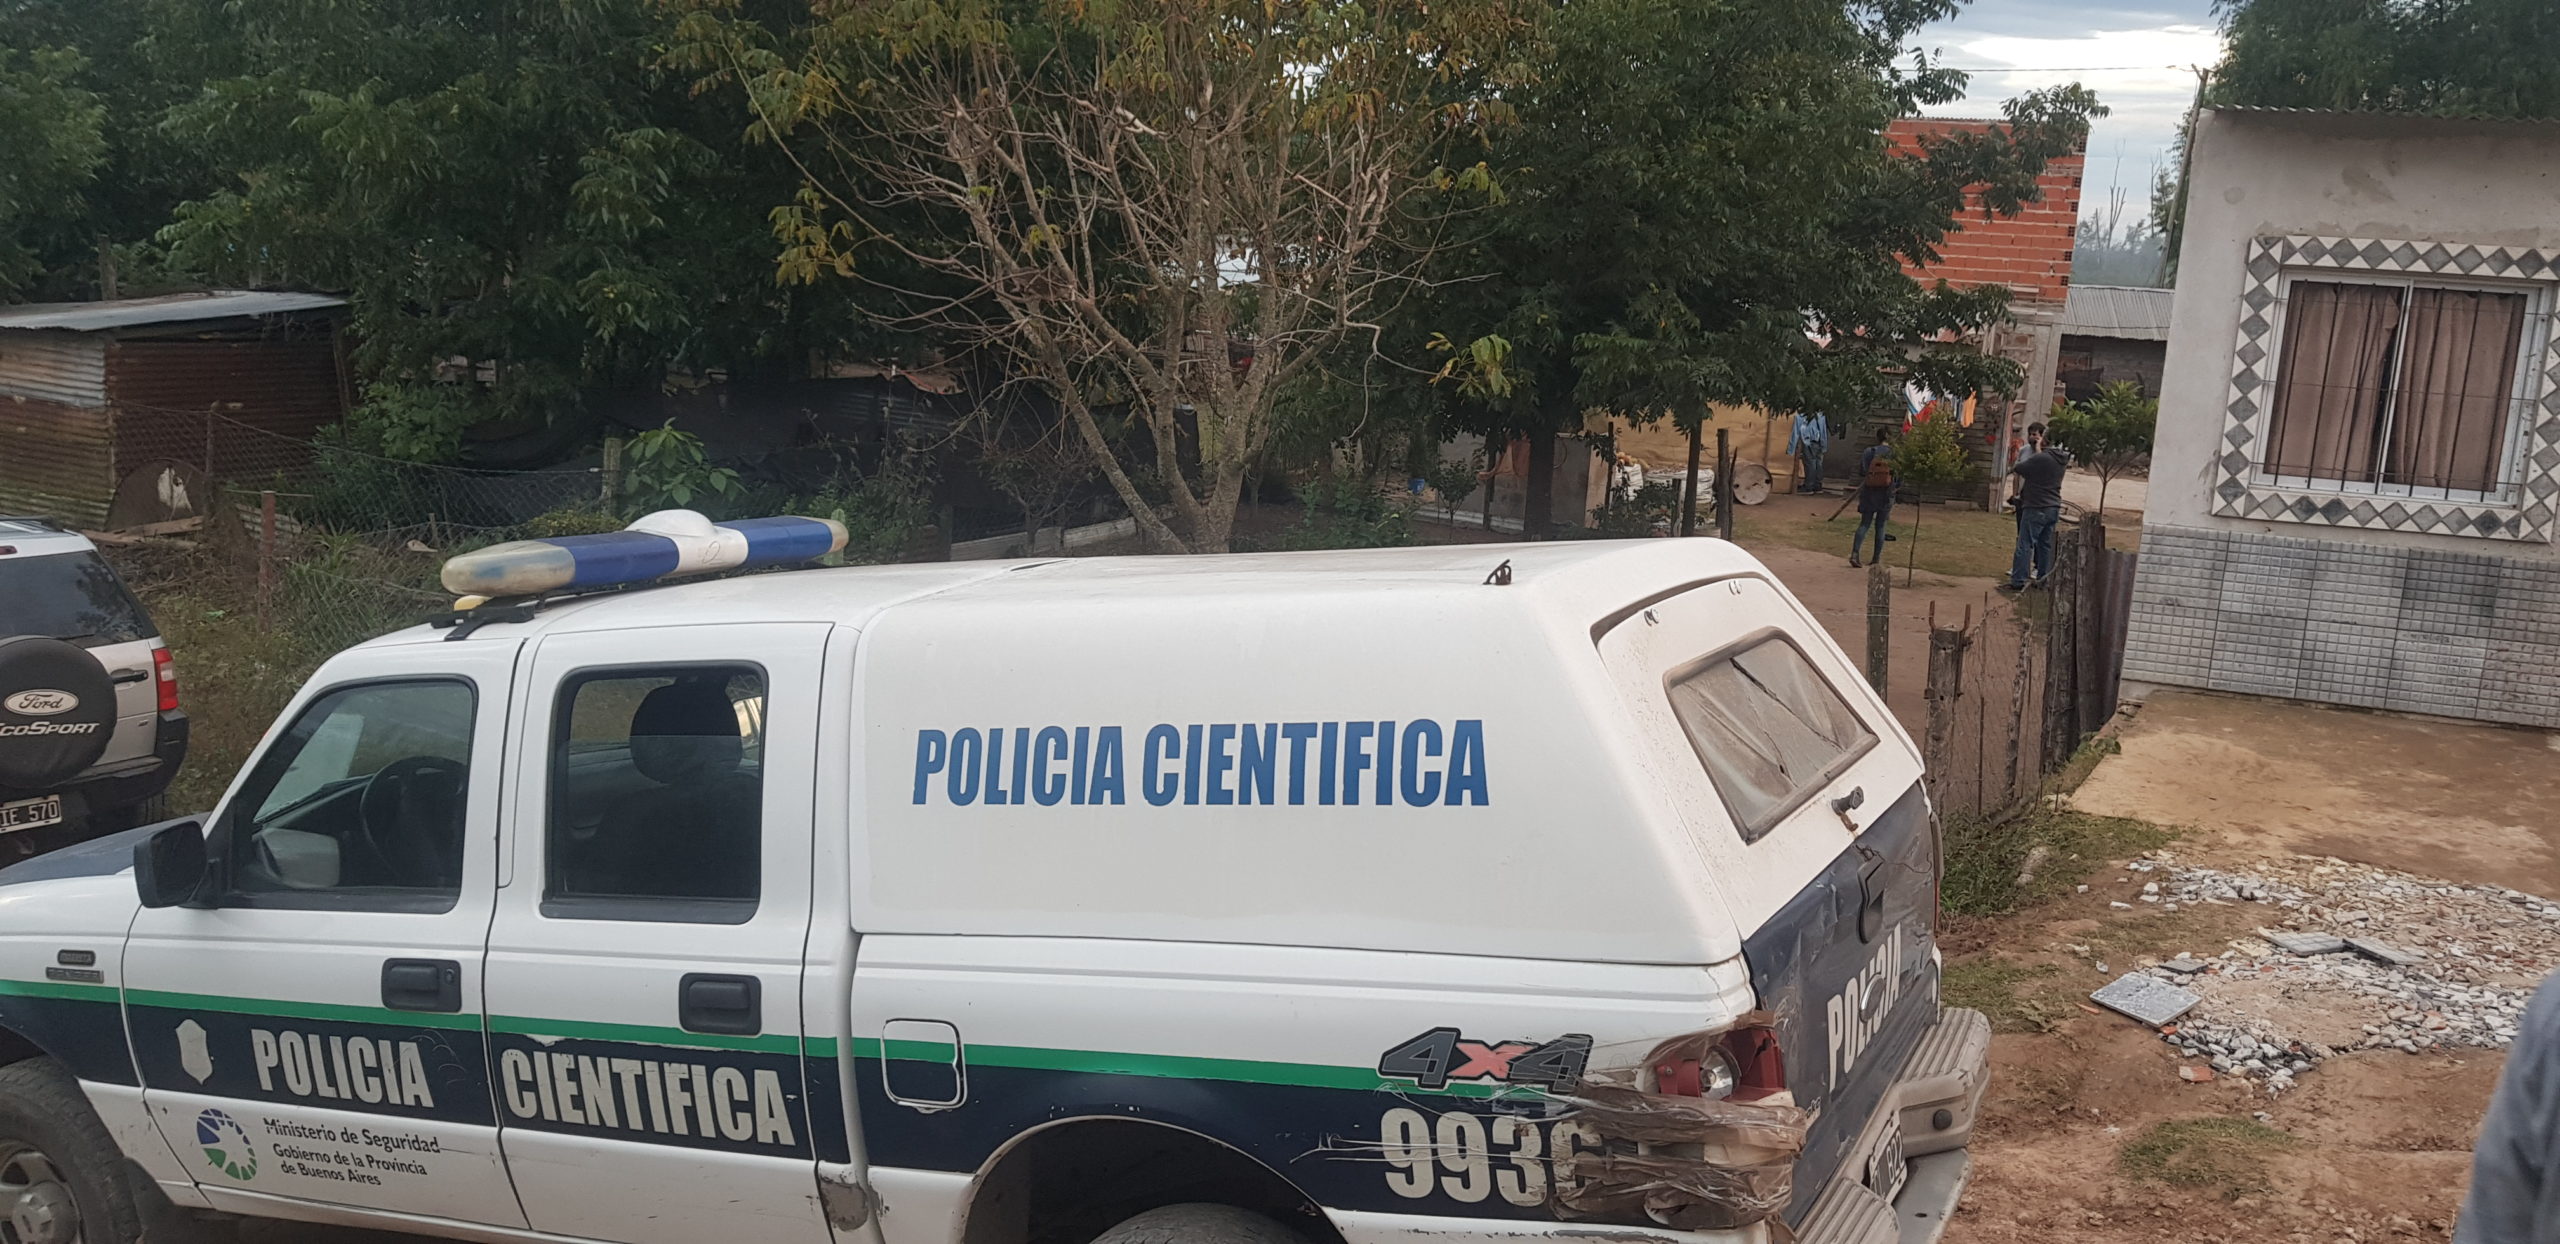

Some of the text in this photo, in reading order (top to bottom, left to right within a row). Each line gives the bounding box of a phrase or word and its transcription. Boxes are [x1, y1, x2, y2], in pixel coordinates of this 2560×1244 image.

[18, 693, 64, 710] Ford
[912, 718, 1490, 808] POLICIA CIENTIFICA
[29, 801, 60, 822] 570
[251, 1028, 435, 1108] POLICIA
[501, 1049, 796, 1146] CIENTIFICA
[263, 1117, 441, 1154] Ministerio de Seguridad
[273, 1142, 428, 1176] Gobierno de la Provincia
[281, 1160, 382, 1186] de Buenos Aires
